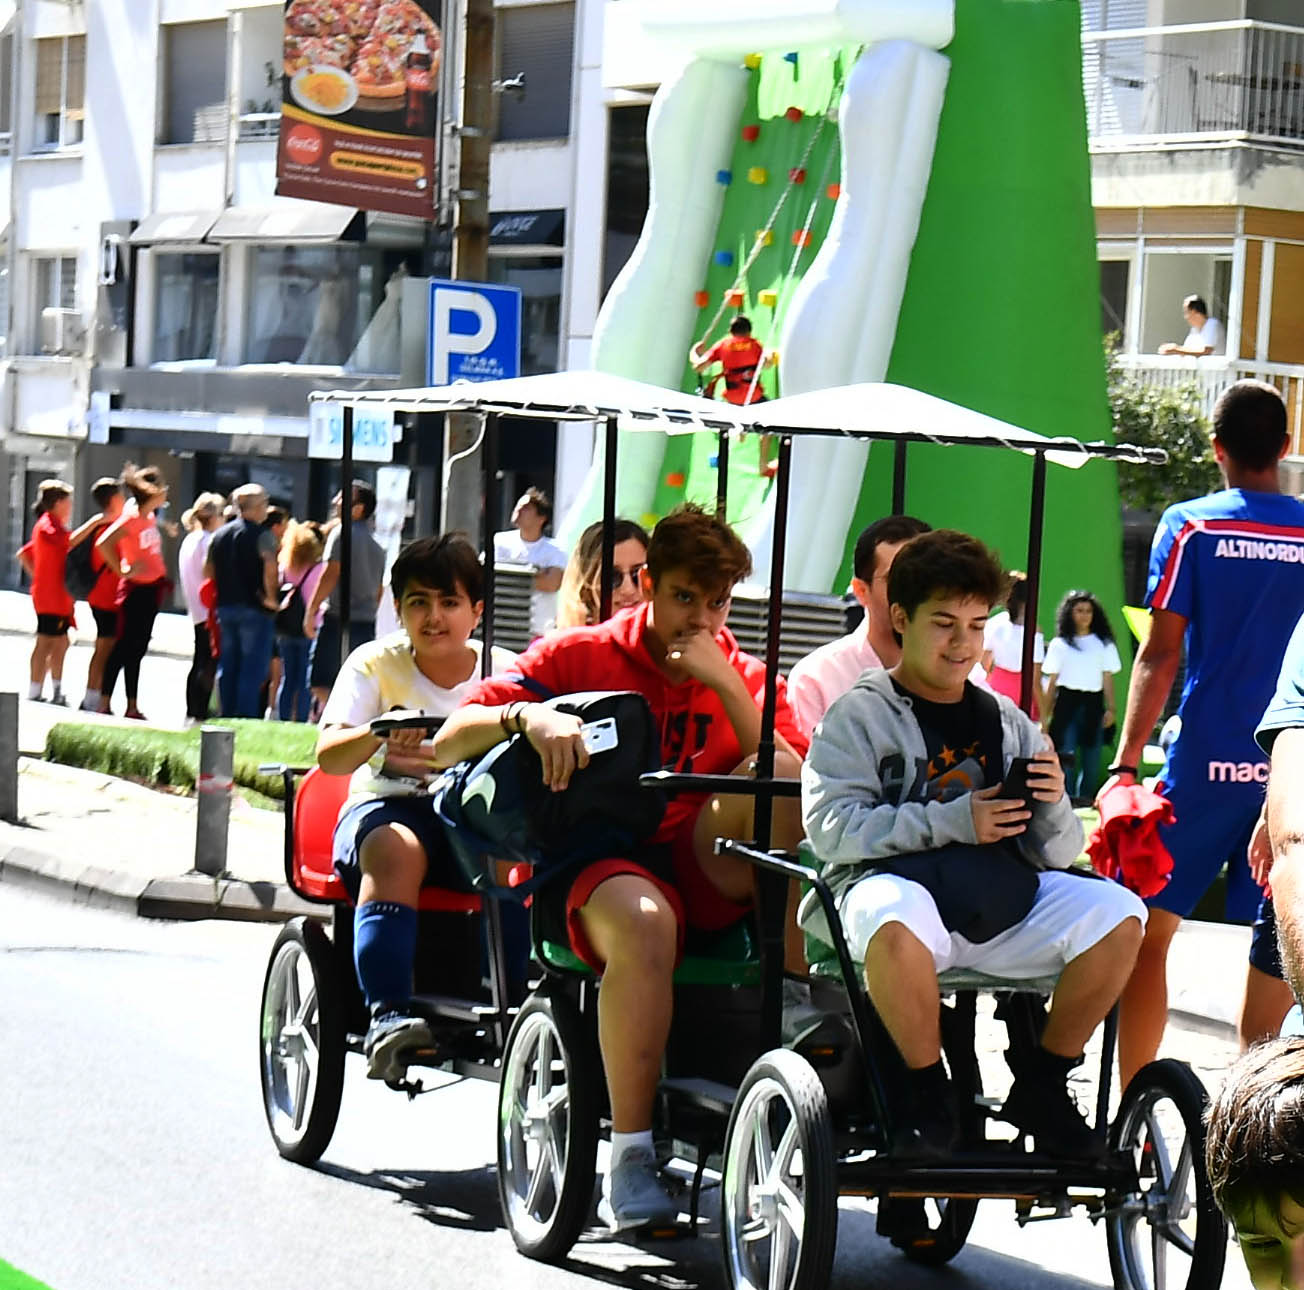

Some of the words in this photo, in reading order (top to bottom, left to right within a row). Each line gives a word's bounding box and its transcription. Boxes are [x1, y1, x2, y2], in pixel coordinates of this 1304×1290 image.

[432, 287, 497, 386] P
[329, 417, 389, 447] SIMENS
[1208, 761, 1269, 782] mac
